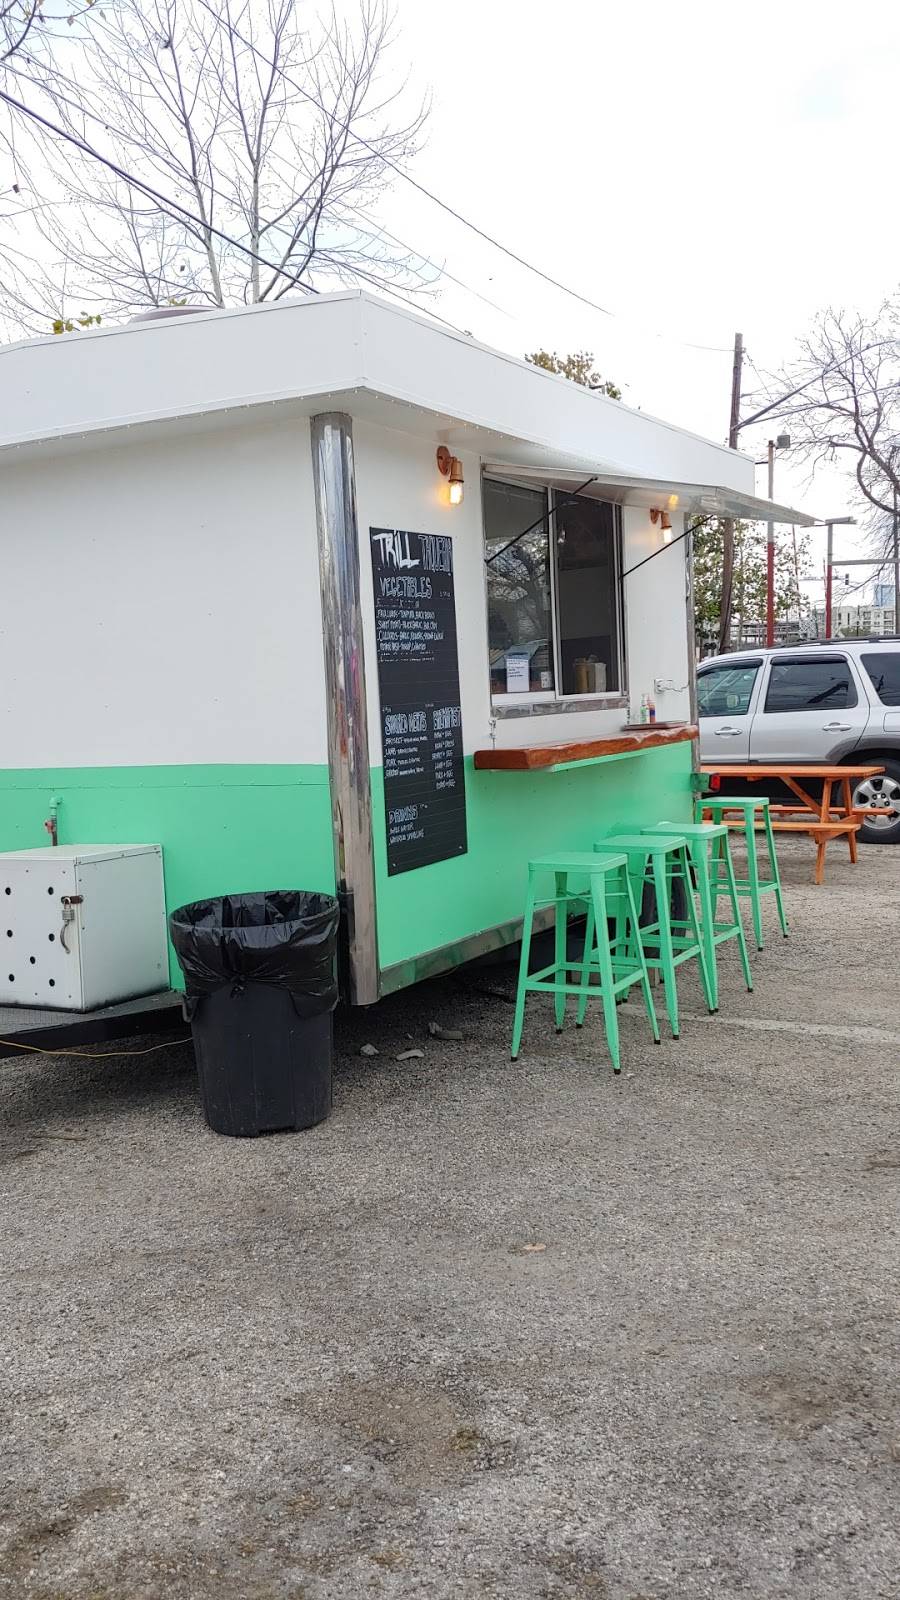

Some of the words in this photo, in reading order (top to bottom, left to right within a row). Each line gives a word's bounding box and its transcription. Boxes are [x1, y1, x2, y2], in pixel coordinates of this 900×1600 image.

[372, 529, 420, 570] TRILL
[379, 576, 433, 598] VEGETABLES
[389, 804, 418, 824] DRINKS
